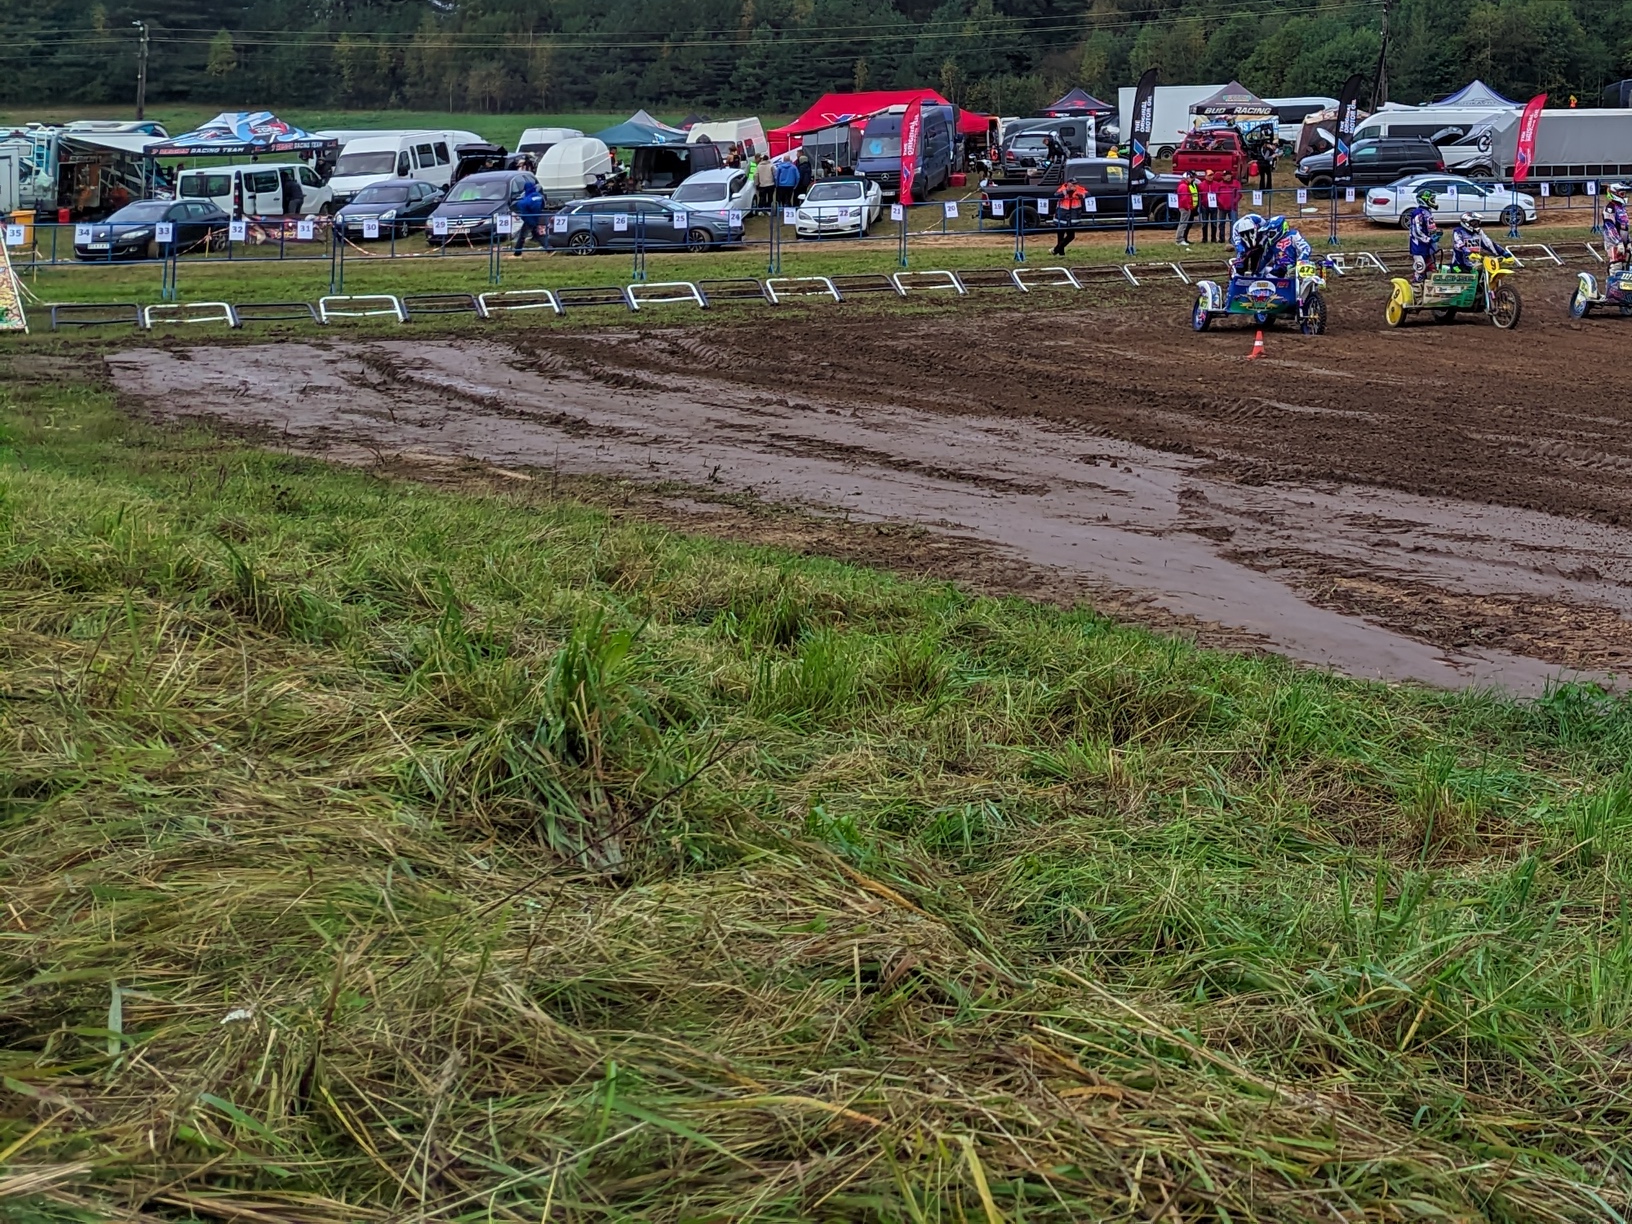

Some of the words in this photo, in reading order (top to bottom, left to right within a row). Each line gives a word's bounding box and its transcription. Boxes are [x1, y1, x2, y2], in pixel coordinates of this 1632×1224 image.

[1234, 106, 1272, 114] RACING
[499, 219, 509, 227] 28
[10, 229, 22, 237] 35
[78, 228, 90, 237] 34
[231, 225, 243, 234] 32
[1491, 260, 1496, 270] 9
